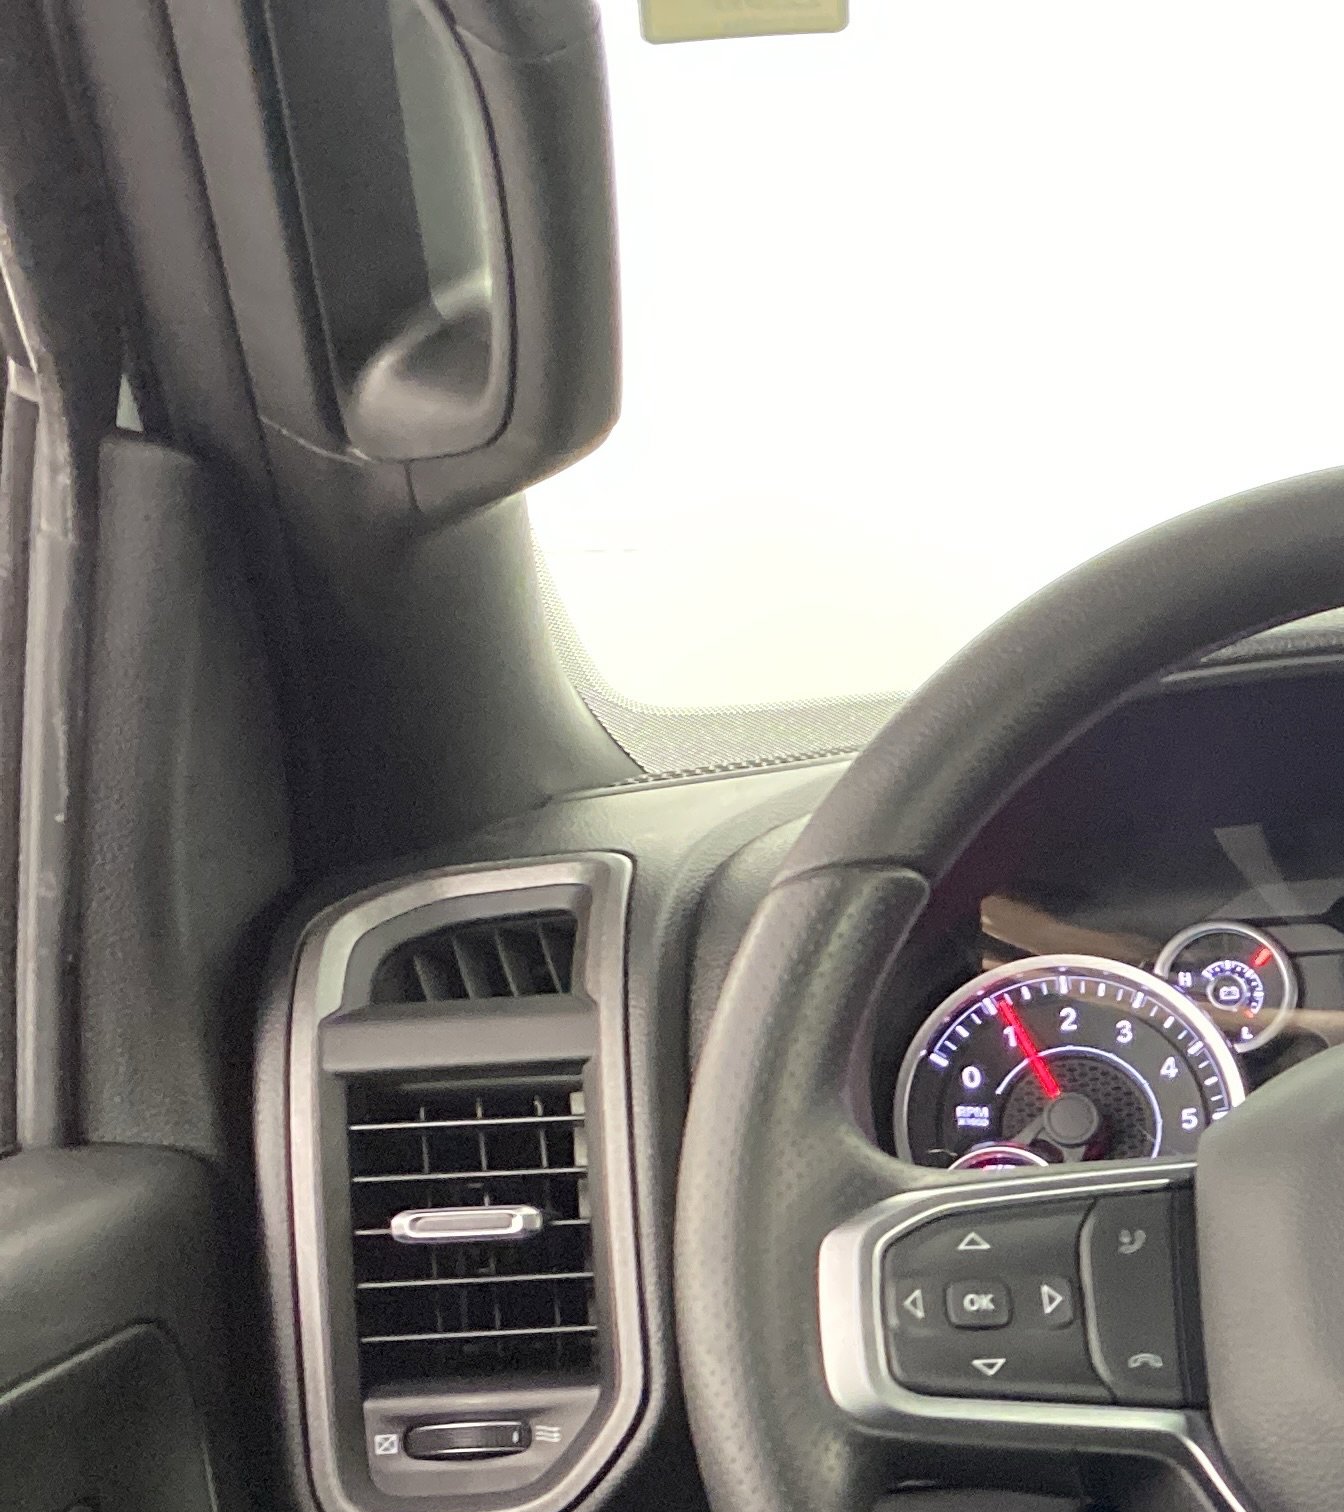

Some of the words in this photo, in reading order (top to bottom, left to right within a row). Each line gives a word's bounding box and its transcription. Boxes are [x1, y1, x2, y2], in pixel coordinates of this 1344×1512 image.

[1059, 1007, 1078, 1031] 2
[1003, 1025, 1017, 1047] 1
[1115, 1020, 1133, 1044] 3
[961, 1066, 982, 1088] 0
[1160, 1056, 1178, 1079] 4
[1181, 1107, 1199, 1130] 5
[963, 1293, 995, 1312] OK
